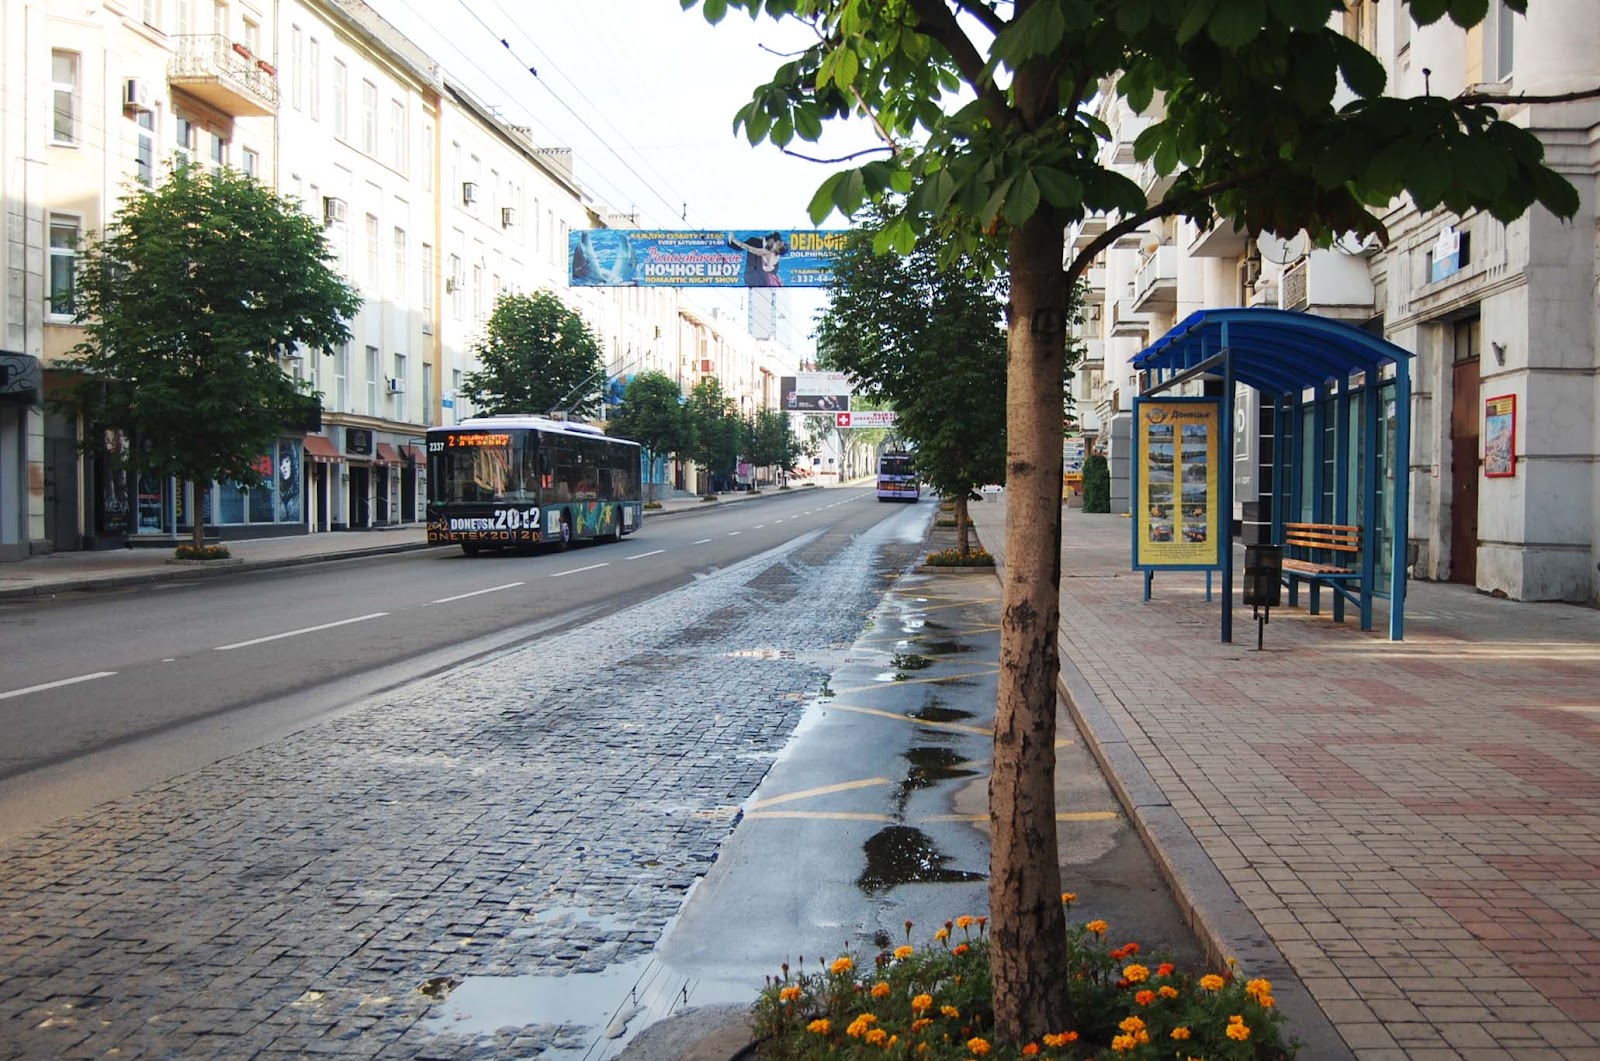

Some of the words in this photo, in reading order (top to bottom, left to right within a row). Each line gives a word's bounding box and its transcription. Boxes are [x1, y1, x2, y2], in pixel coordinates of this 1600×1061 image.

[645, 264, 704, 276] НОЧНОЕ
[707, 264, 741, 276] ШОУ
[448, 434, 455, 447] 2
[429, 442, 444, 452] 2337
[494, 507, 540, 529] 2012
